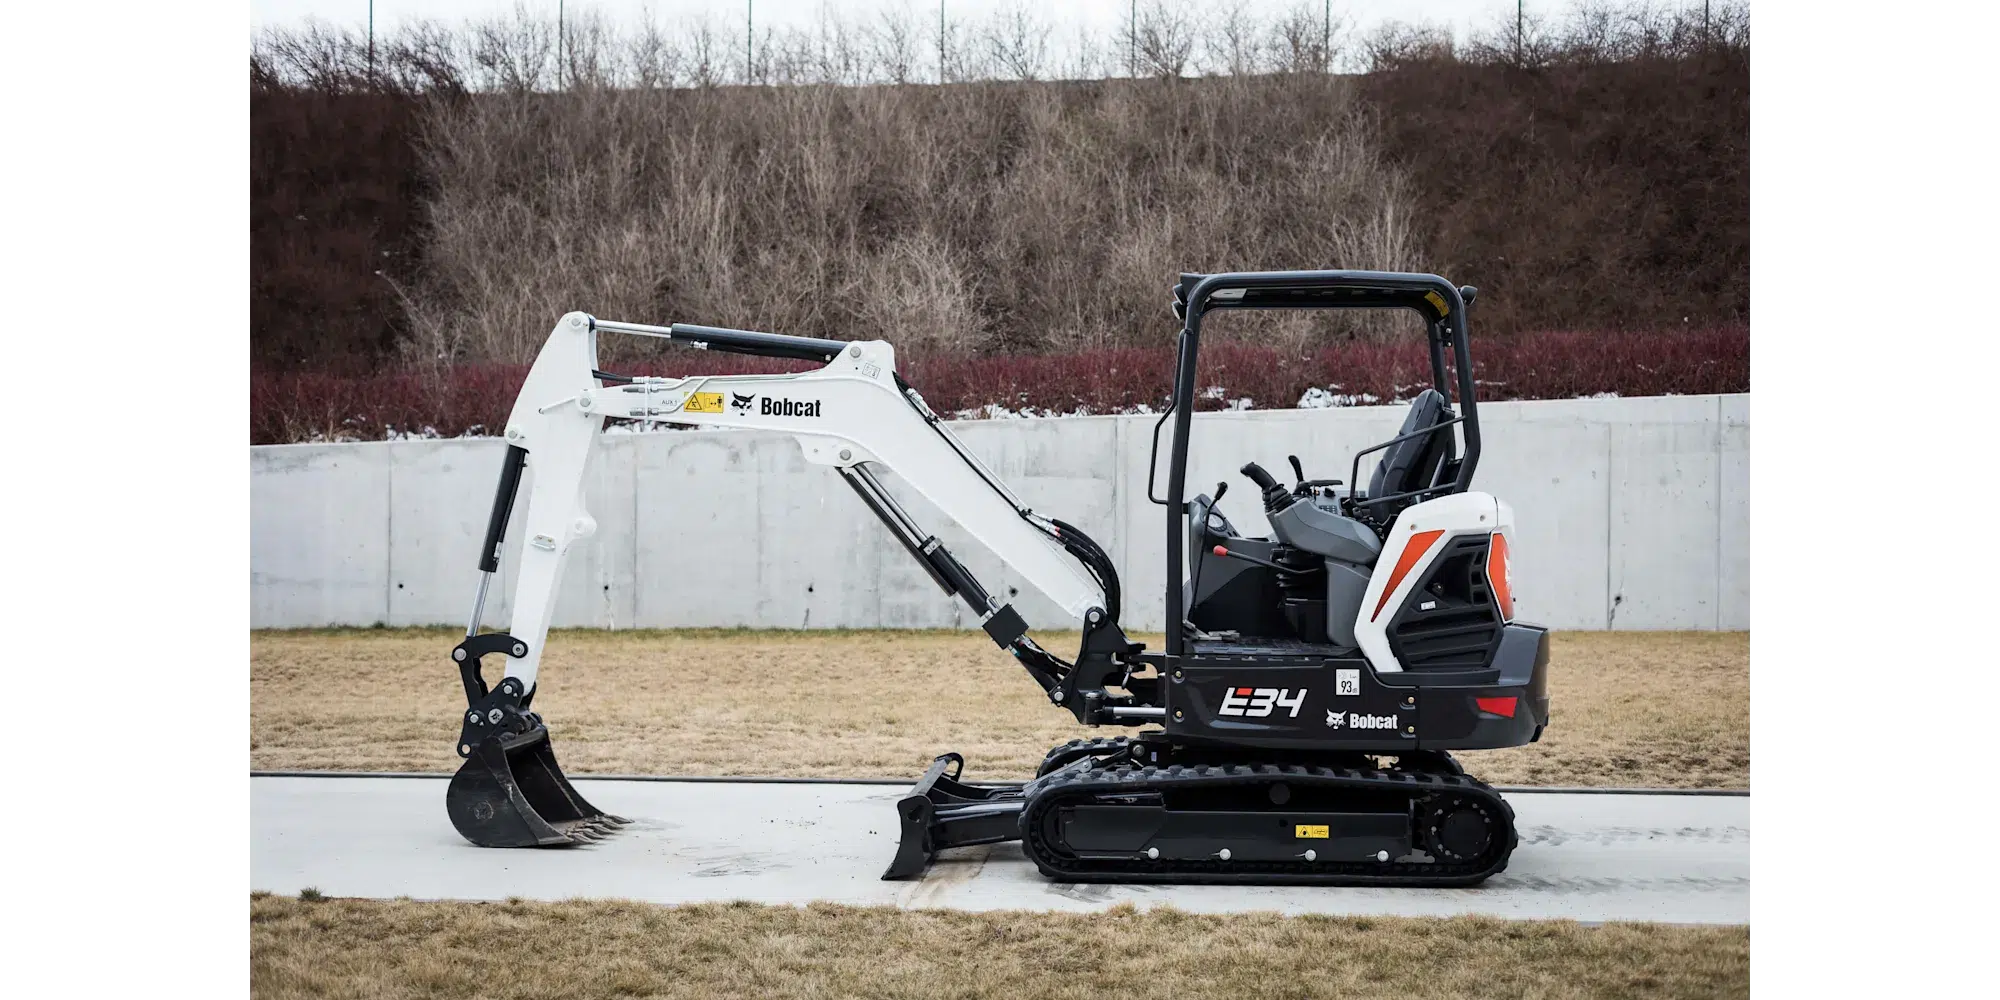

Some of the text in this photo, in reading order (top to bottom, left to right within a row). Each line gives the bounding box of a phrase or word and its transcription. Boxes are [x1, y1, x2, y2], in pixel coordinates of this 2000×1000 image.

[761, 397, 821, 417] Bobcat
[1341, 680, 1352, 693] 93
[1218, 687, 1308, 718] E34
[1349, 713, 1398, 729] Bobcat
